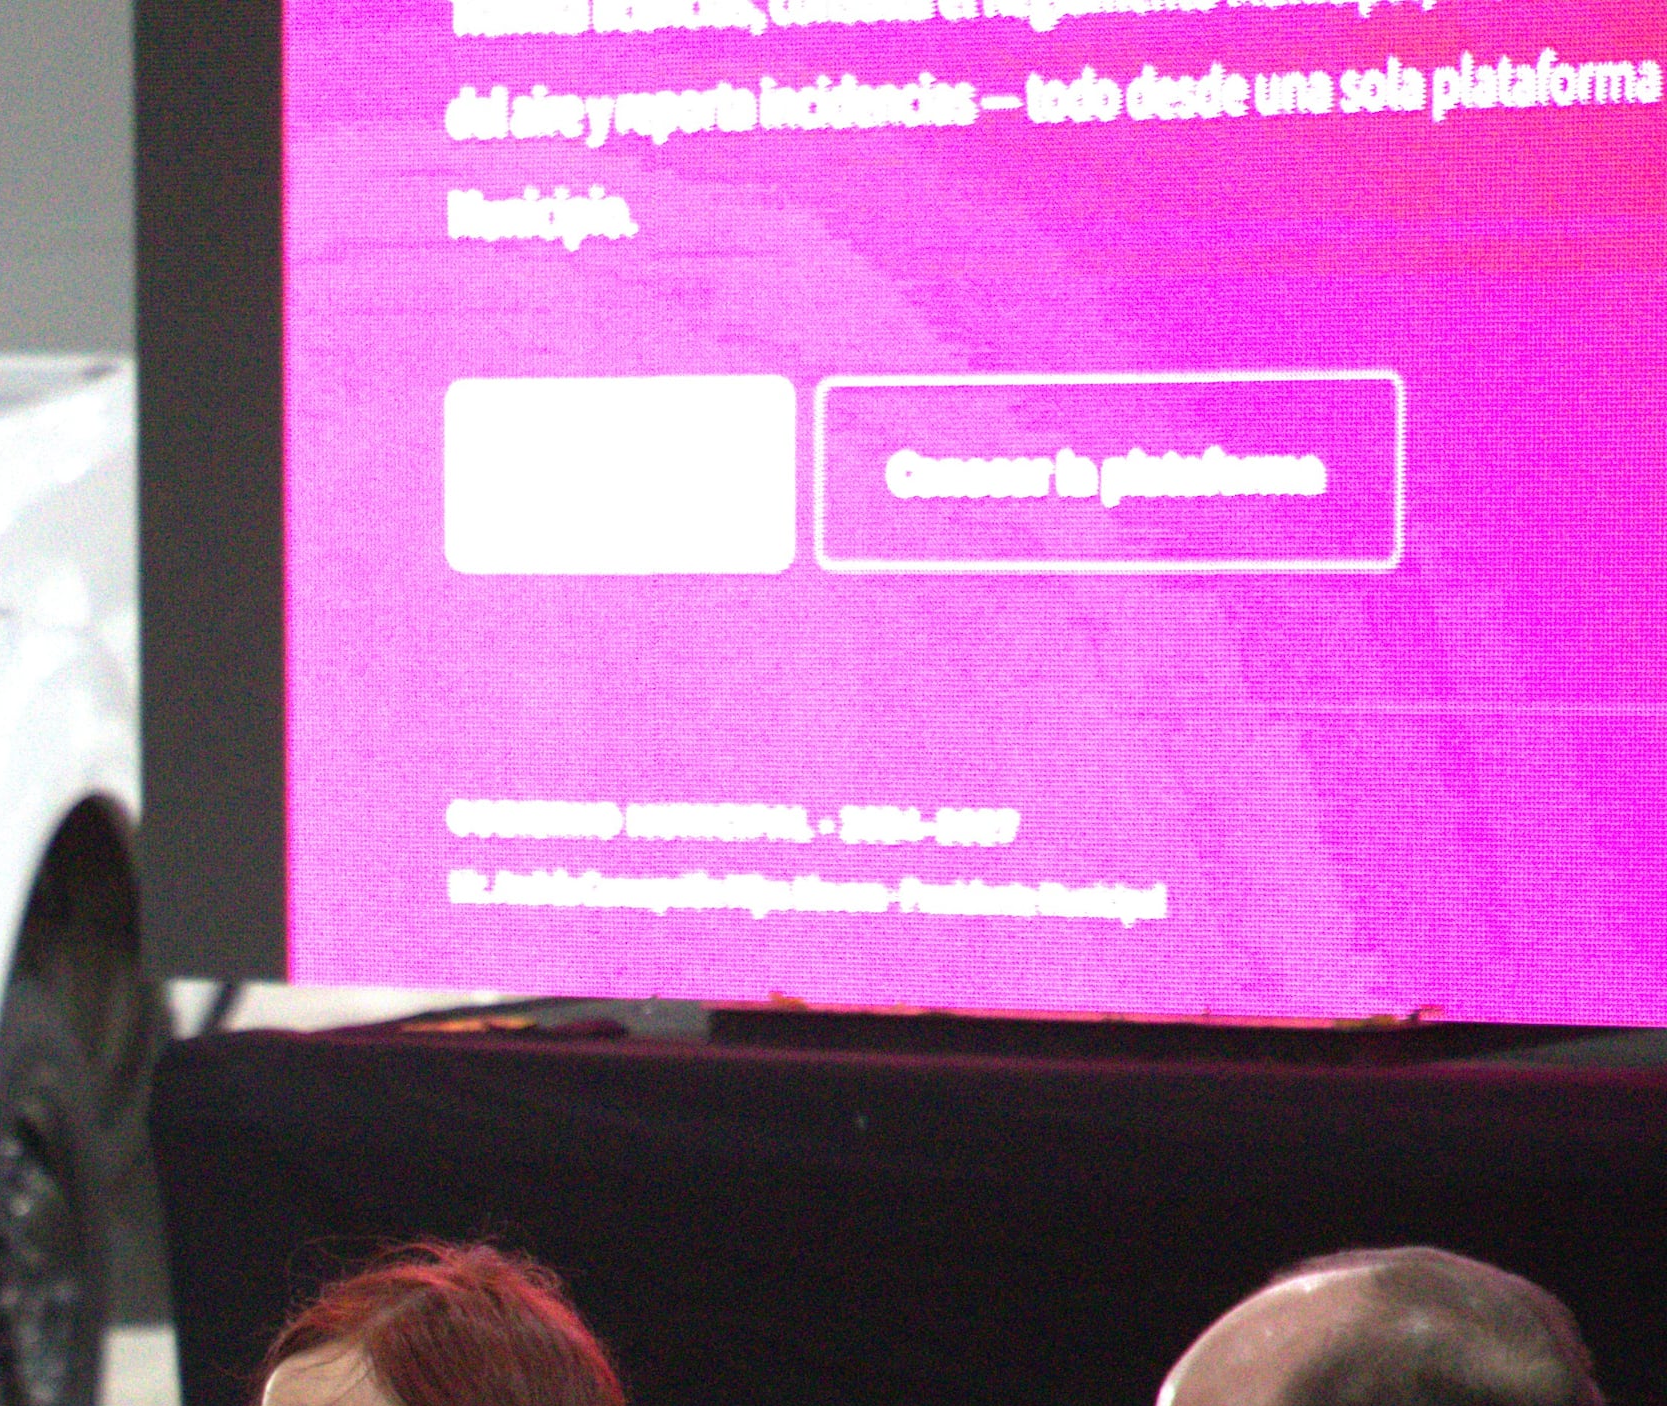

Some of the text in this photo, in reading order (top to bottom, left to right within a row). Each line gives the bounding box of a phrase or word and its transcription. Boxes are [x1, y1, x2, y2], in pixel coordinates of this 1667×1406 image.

[580, 93, 611, 148] y
[1025, 67, 1122, 124] todo
[1126, 64, 1250, 121] desde
[1255, 71, 1333, 116] una
[1340, 57, 1426, 112] sola
[1433, 48, 1662, 122] plataforma
